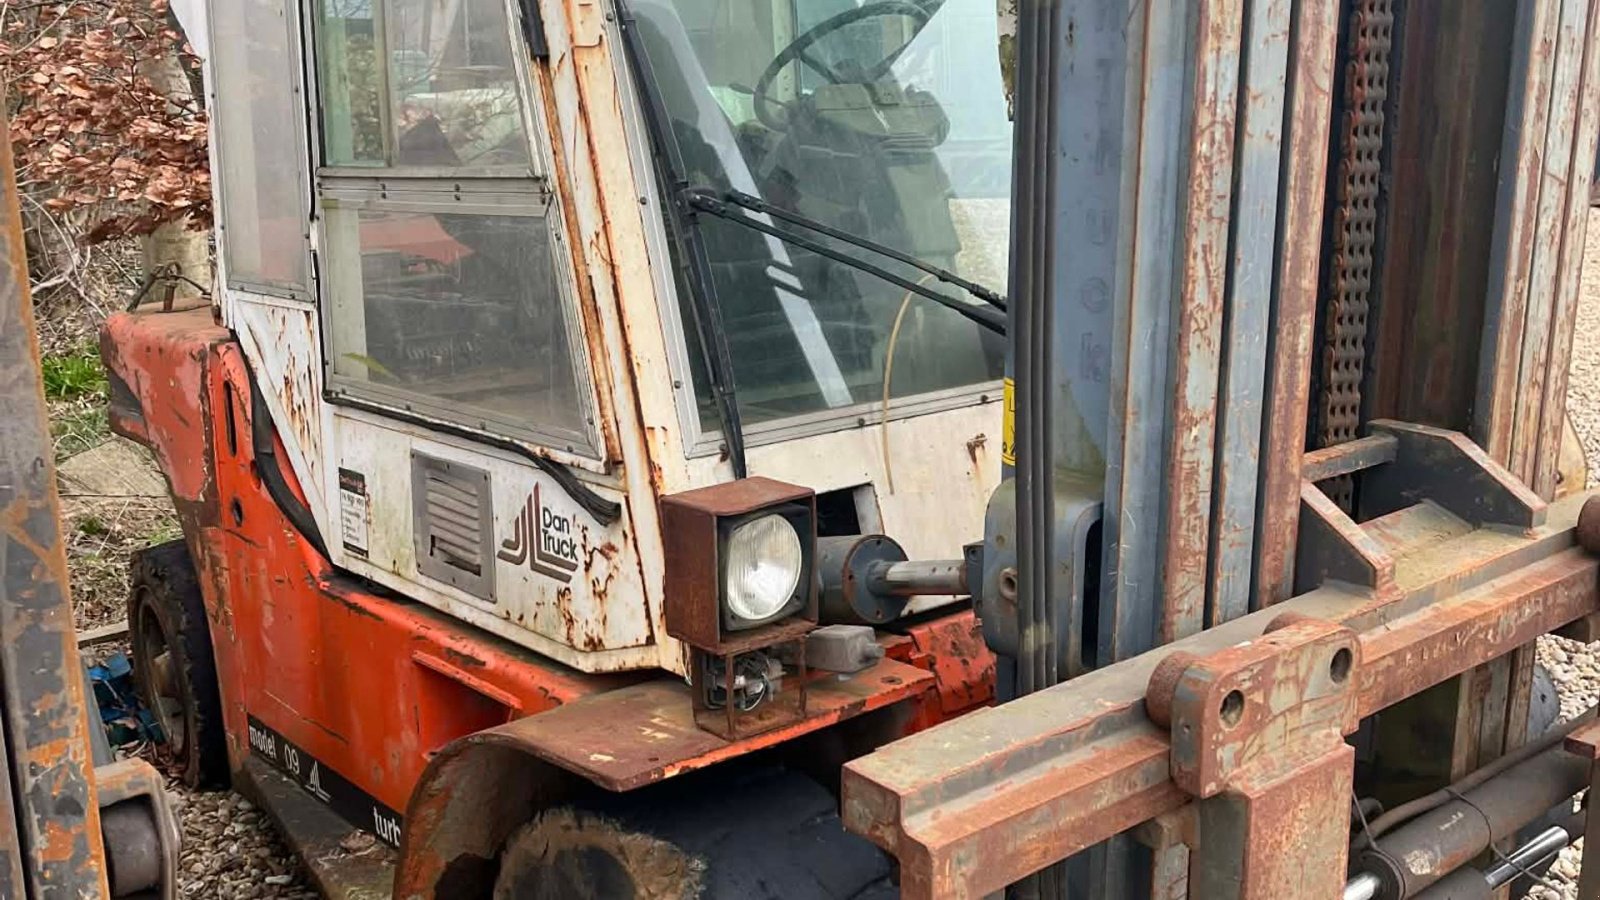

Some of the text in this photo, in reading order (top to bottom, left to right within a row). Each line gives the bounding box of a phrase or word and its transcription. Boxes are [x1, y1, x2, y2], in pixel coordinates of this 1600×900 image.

[542, 506, 570, 534] Dan
[542, 528, 578, 561] Truck
[248, 725, 300, 774] model 09
